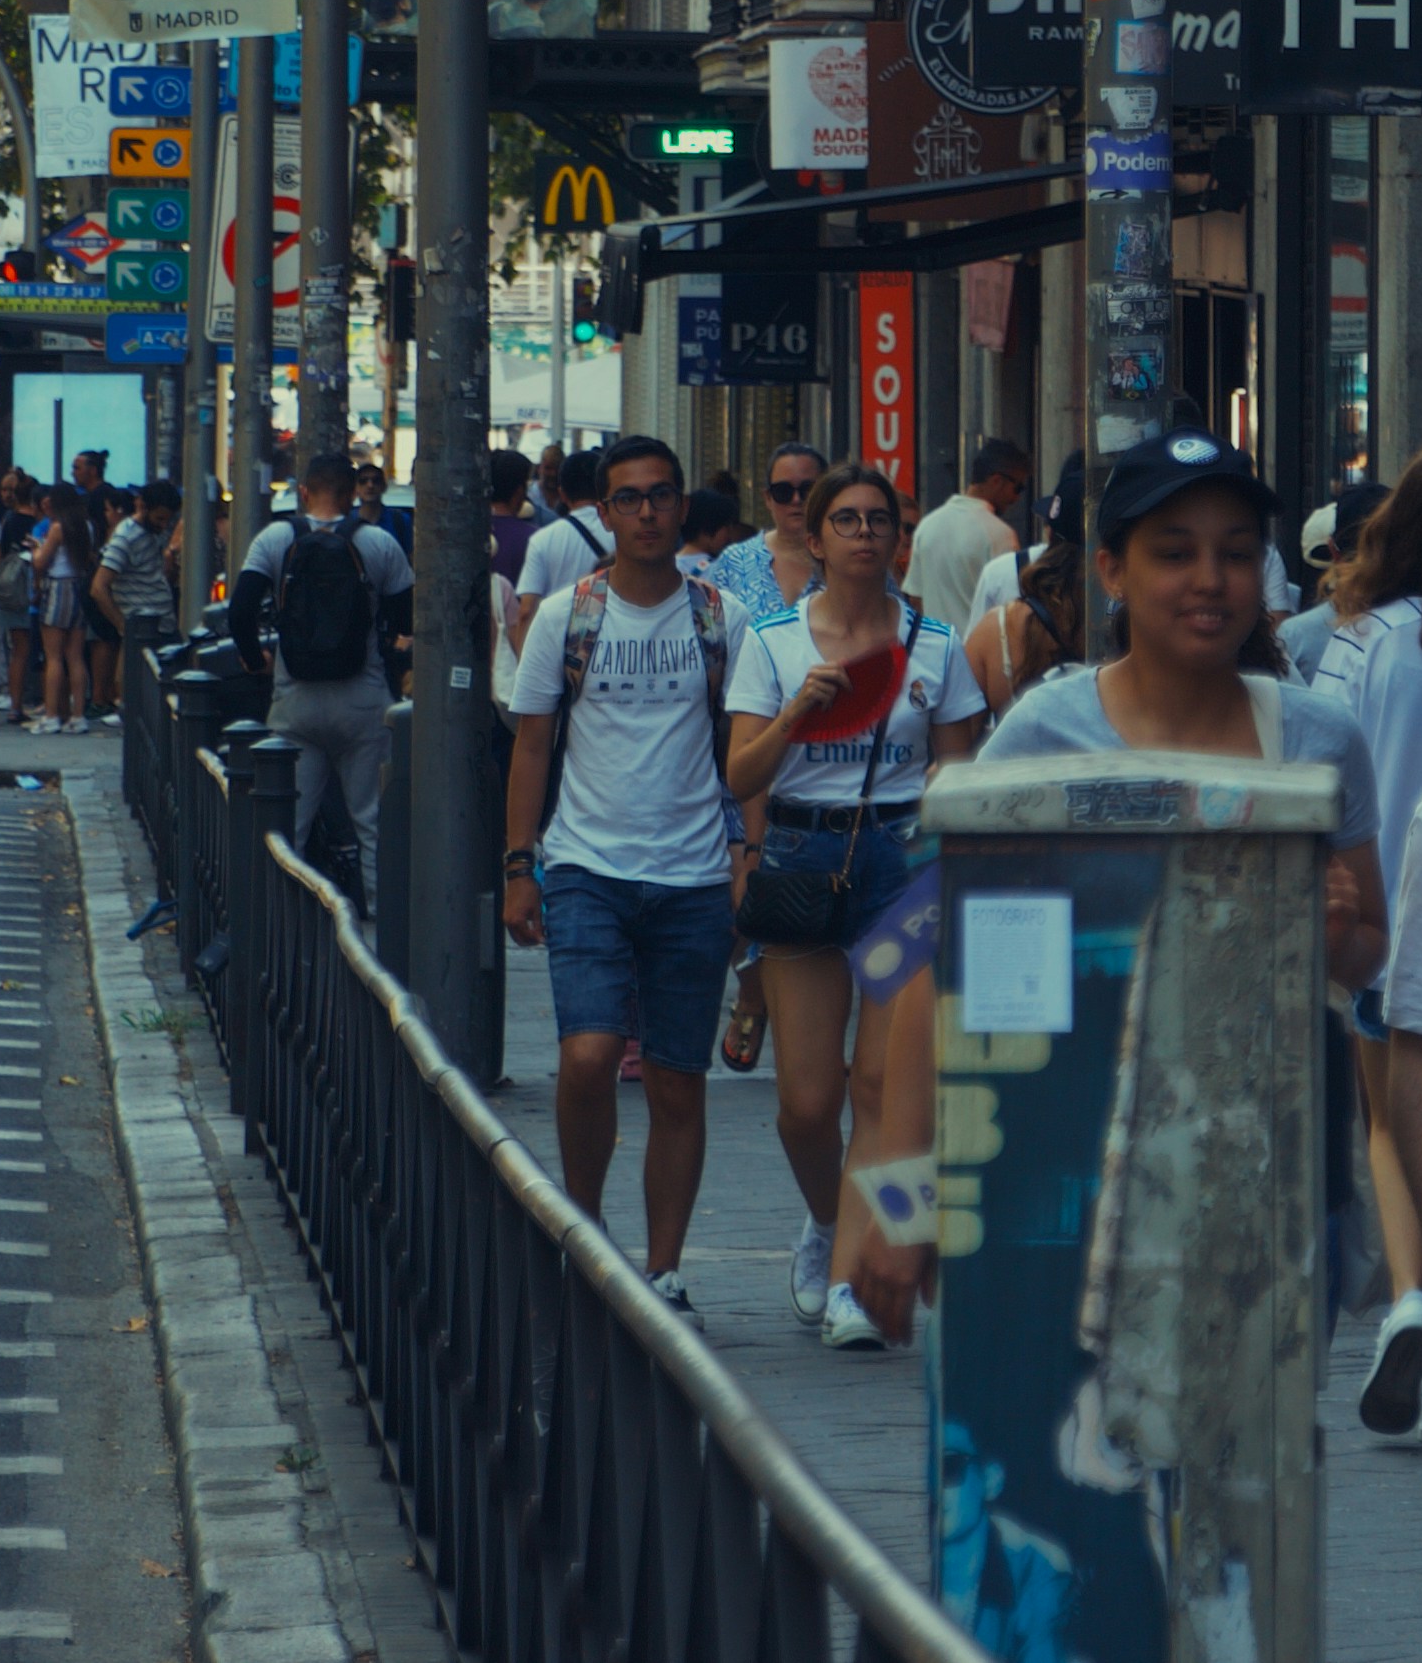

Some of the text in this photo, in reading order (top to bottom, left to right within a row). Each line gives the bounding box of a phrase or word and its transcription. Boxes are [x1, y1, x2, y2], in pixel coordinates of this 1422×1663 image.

[156, 10, 239, 29] MADRID
[927, 57, 1017, 107] ELABORADAS
[661, 129, 735, 154] LIBRE
[730, 323, 808, 354] P46
[590, 638, 699, 675] CANDINAVIA
